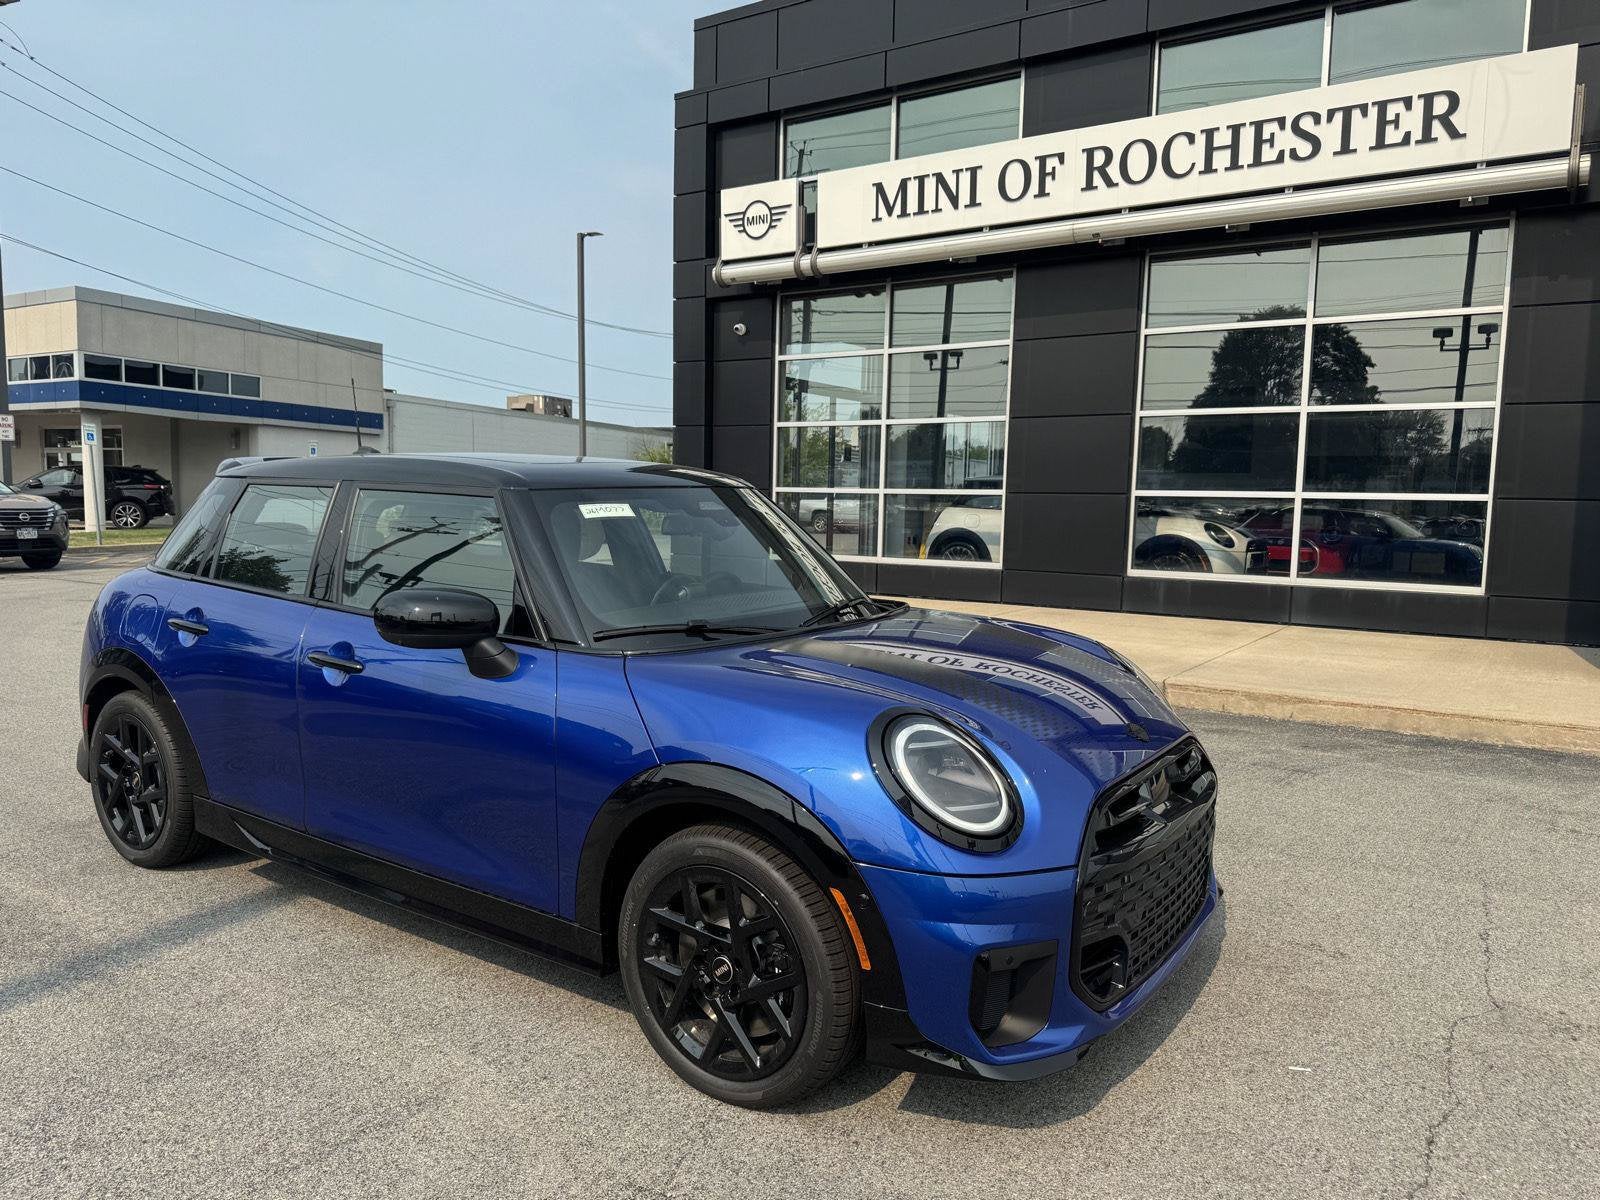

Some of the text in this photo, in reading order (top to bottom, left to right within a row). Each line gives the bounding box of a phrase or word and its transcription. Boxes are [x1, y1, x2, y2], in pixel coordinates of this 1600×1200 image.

[872, 90, 1467, 223] MINI OF ROCHESTER
[746, 214, 769, 227] MINI
[714, 963, 730, 977] MINI
